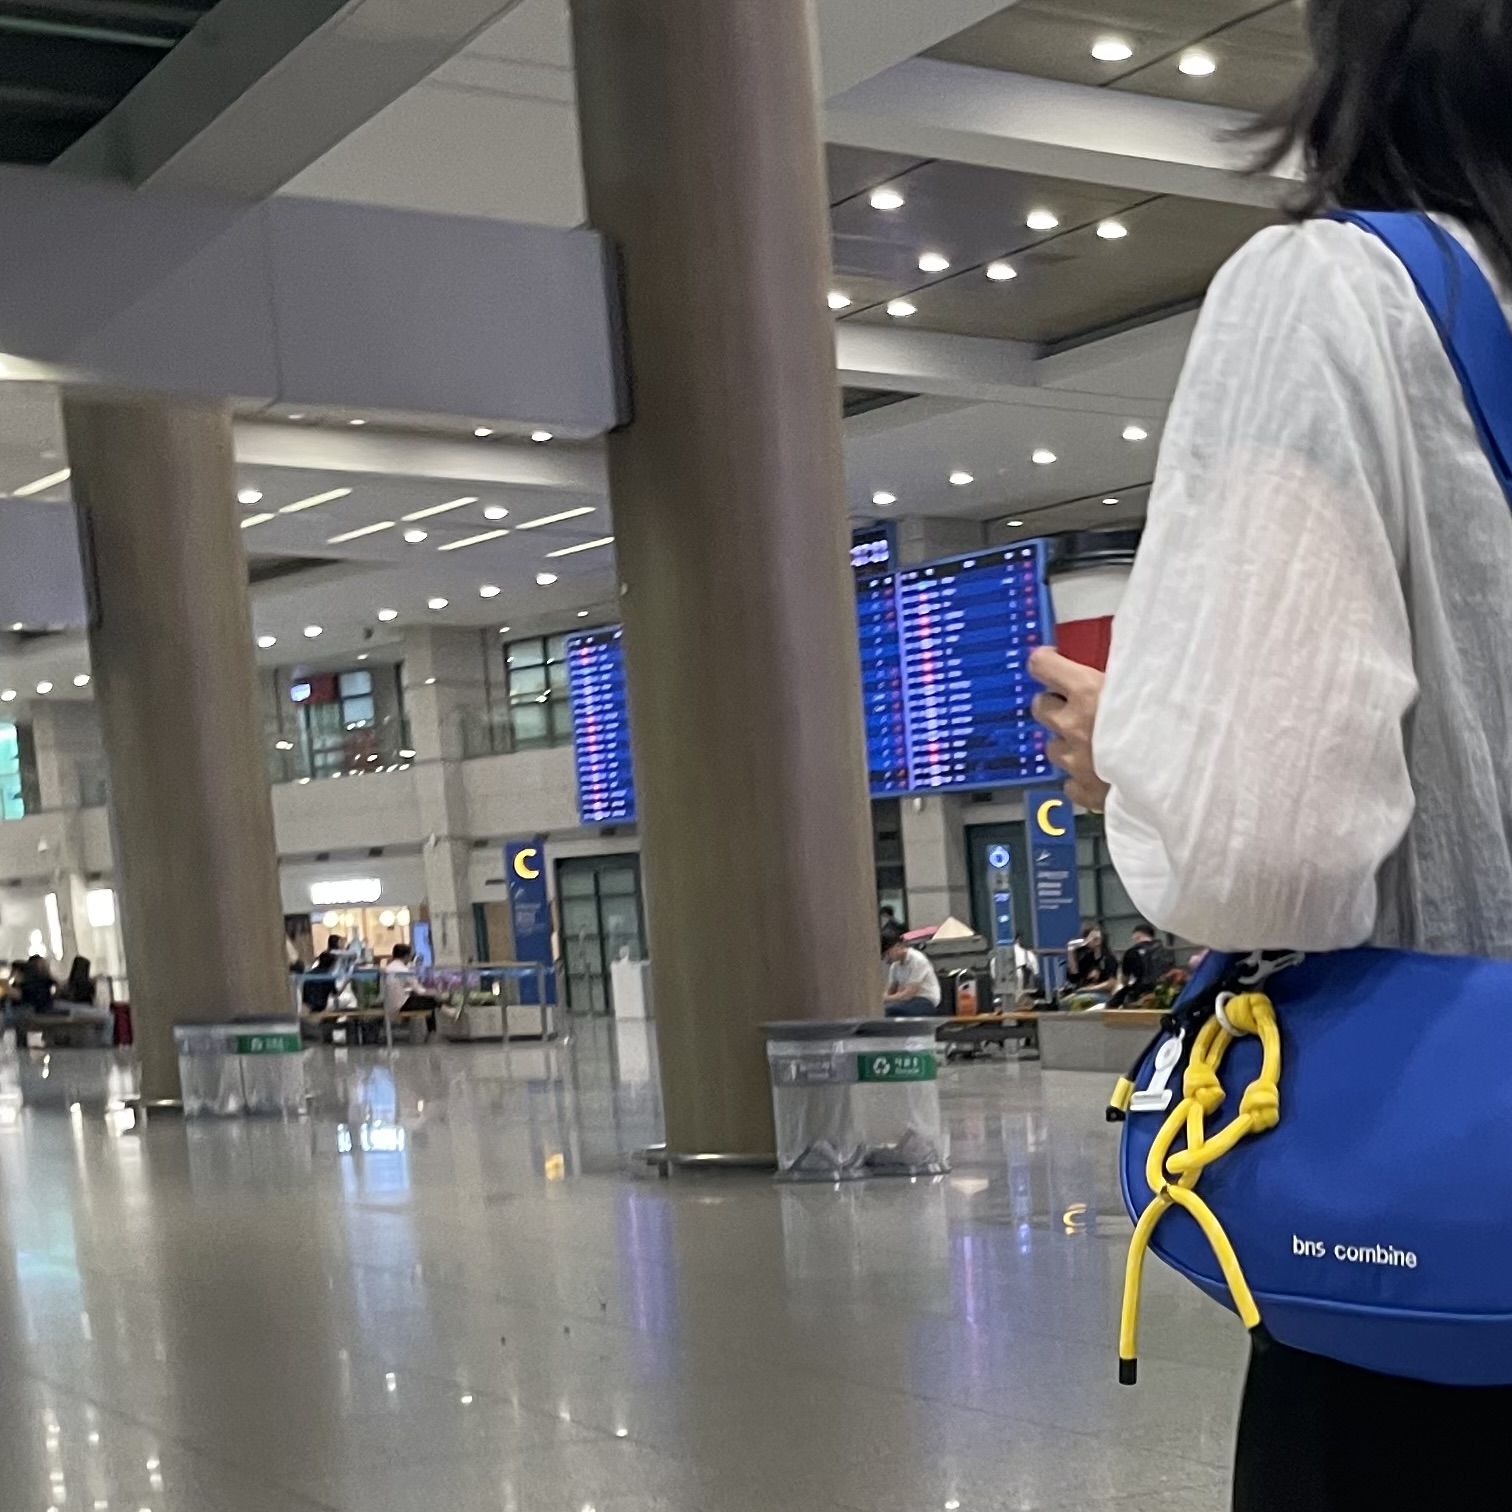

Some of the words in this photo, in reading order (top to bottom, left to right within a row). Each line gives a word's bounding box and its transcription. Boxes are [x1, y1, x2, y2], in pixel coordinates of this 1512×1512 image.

[1037, 799, 1066, 836] C
[513, 848, 540, 880] C
[1292, 1233, 1326, 1258] bns
[1334, 1243, 1418, 1269] combine
